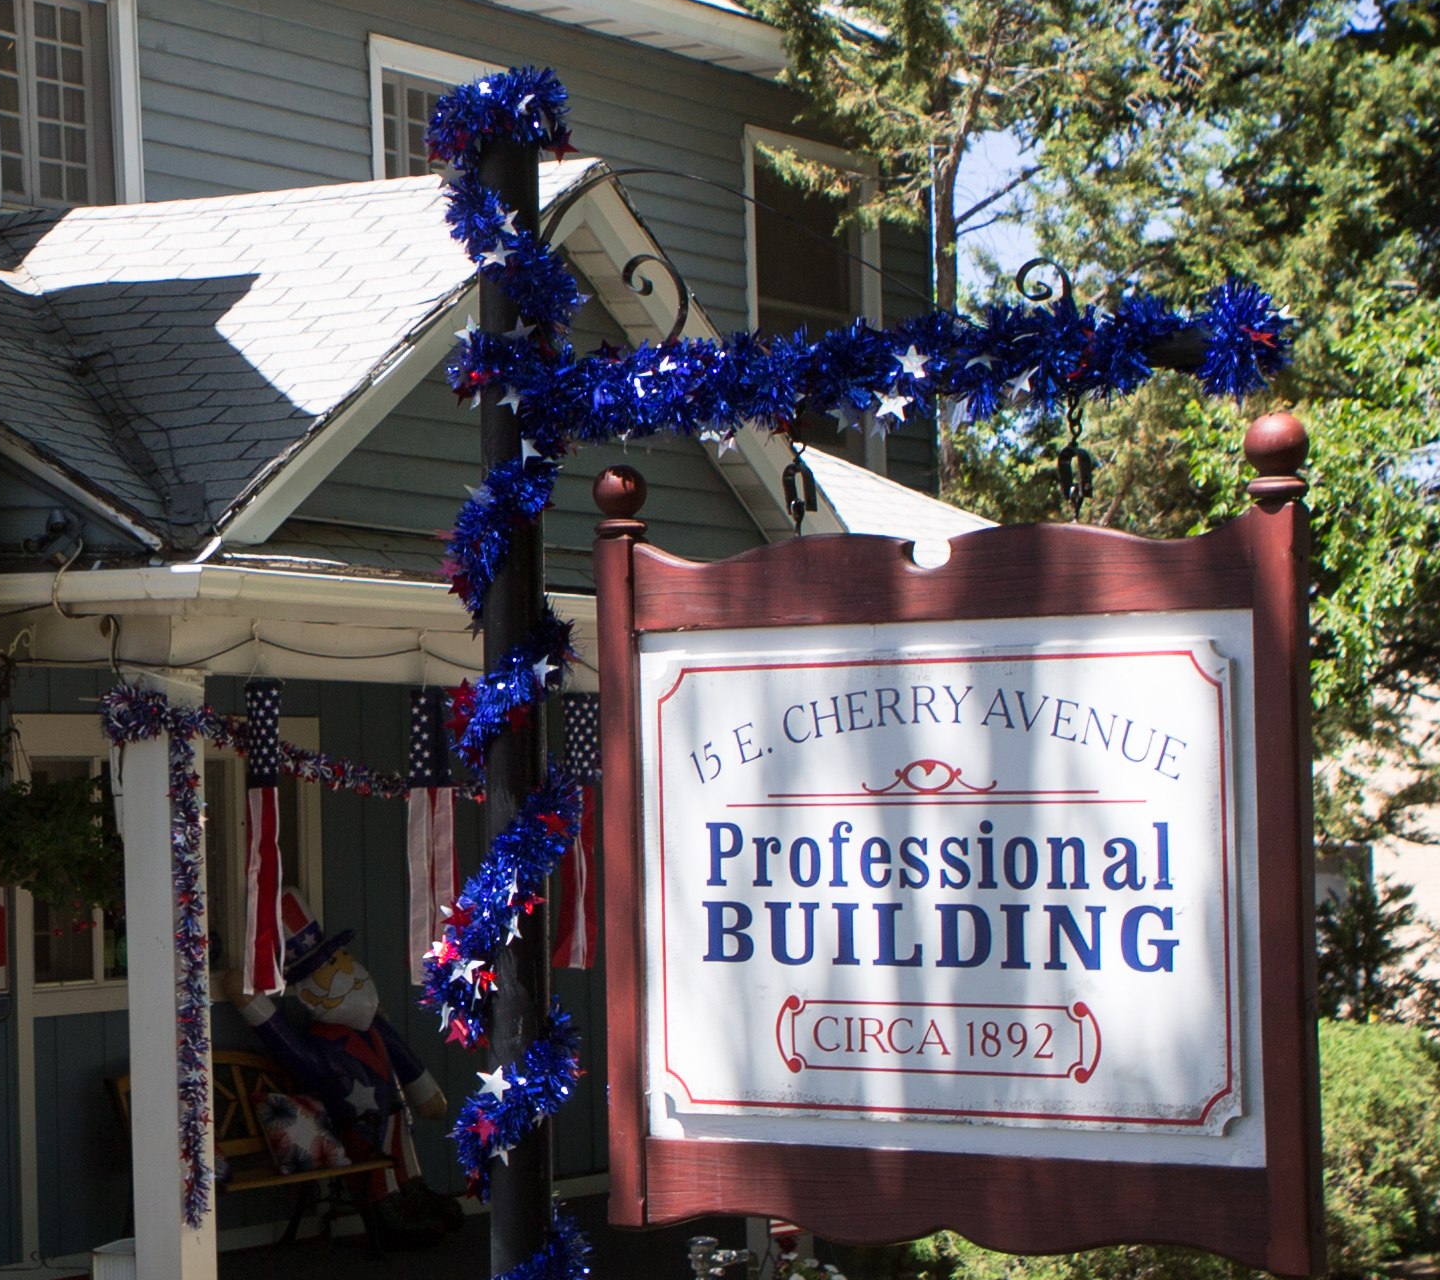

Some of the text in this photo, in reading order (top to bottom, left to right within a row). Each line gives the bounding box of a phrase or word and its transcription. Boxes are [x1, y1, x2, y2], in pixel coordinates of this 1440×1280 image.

[689, 684, 1188, 785] 15 E. CHERRY AVENUE
[704, 820, 1176, 891] Professional
[701, 900, 1181, 974] BUILDING
[812, 1015, 1056, 1060] CIRCA 1892
